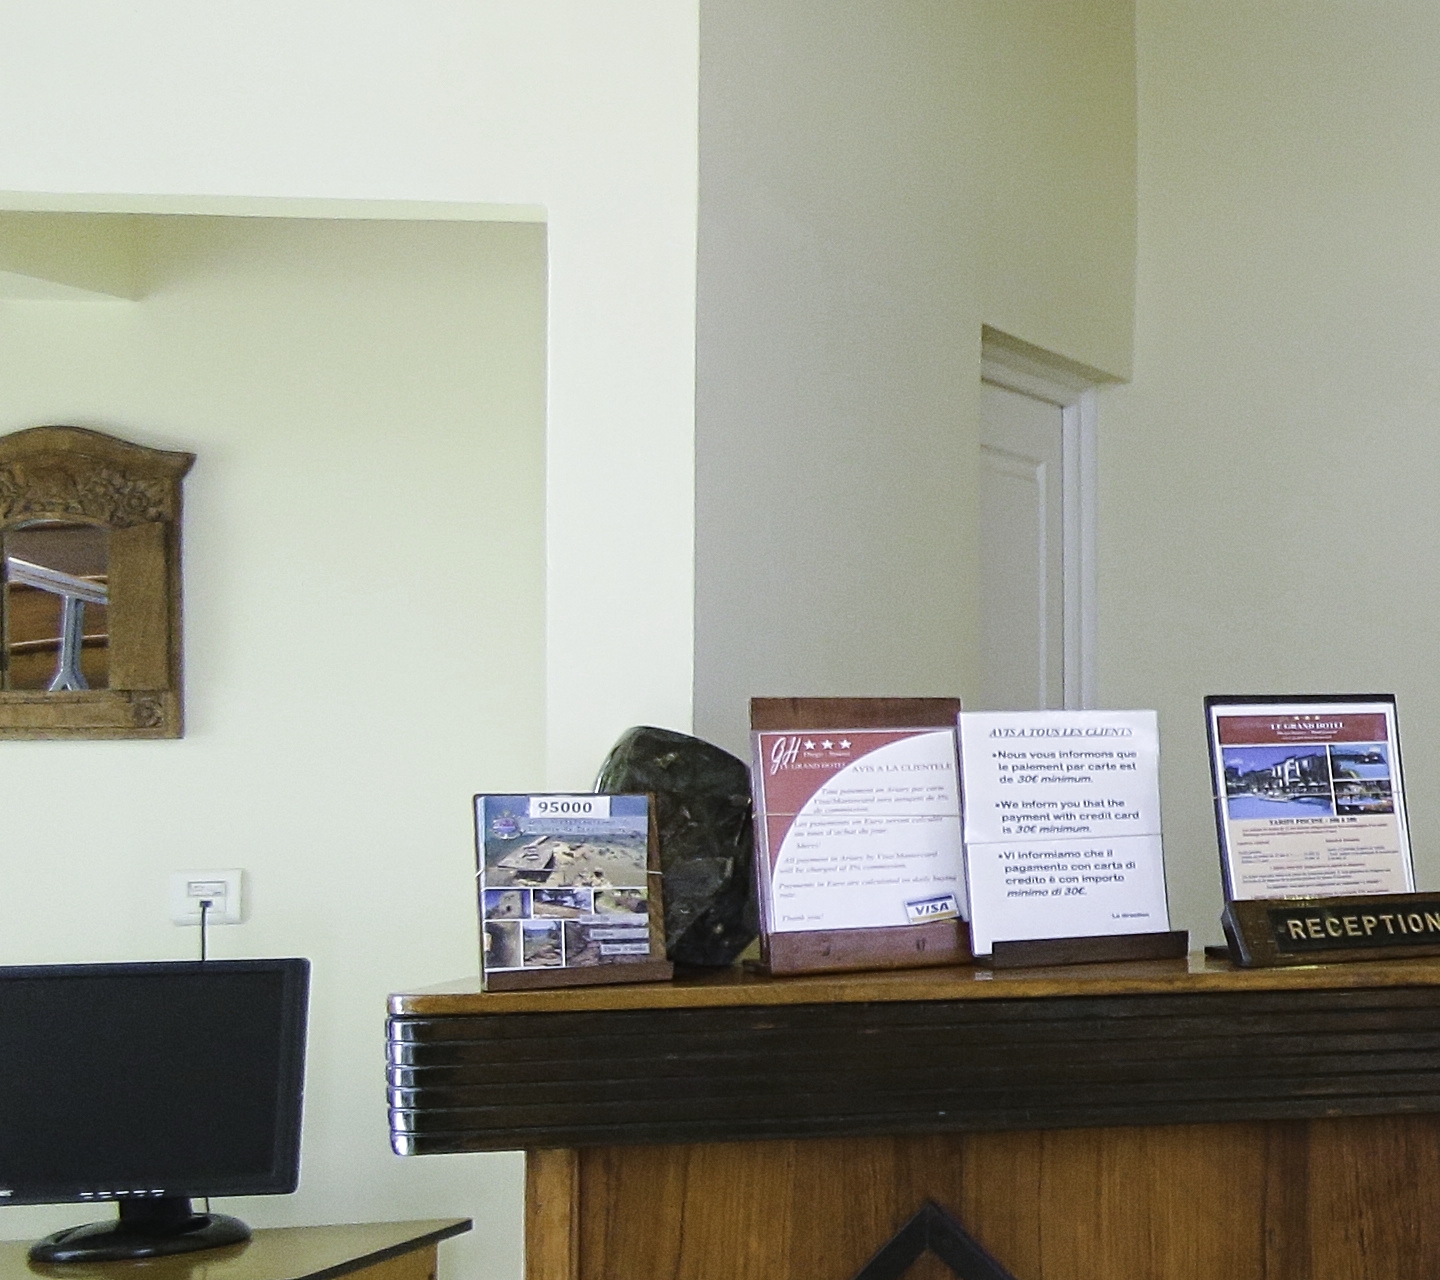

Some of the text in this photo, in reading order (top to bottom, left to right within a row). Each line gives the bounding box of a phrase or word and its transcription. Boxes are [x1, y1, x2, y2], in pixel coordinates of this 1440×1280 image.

[989, 728, 1016, 738] AVIS
[1017, 728, 1026, 738] A
[1030, 727, 1060, 738] TOUS
[1063, 727, 1082, 738] LES
[998, 749, 1137, 761] Nous vous informons que
[998, 762, 1009, 771] le
[1066, 764, 1085, 773] par
[1088, 761, 1117, 771] carte
[1120, 761, 1137, 771] est
[999, 774, 1014, 784] de
[538, 801, 593, 813] 95000
[1000, 798, 1125, 811] We inform you that the
[1002, 810, 1140, 824] payment with credit card
[1002, 825, 1013, 835] is
[1018, 849, 1081, 859] informiamo
[1083, 848, 1104, 858] che
[1004, 860, 1136, 874] pagamento con carta di
[1005, 875, 1047, 885] credito
[1058, 876, 1079, 884] con
[1081, 873, 1126, 885] importo
[915, 901, 950, 916] VISA
